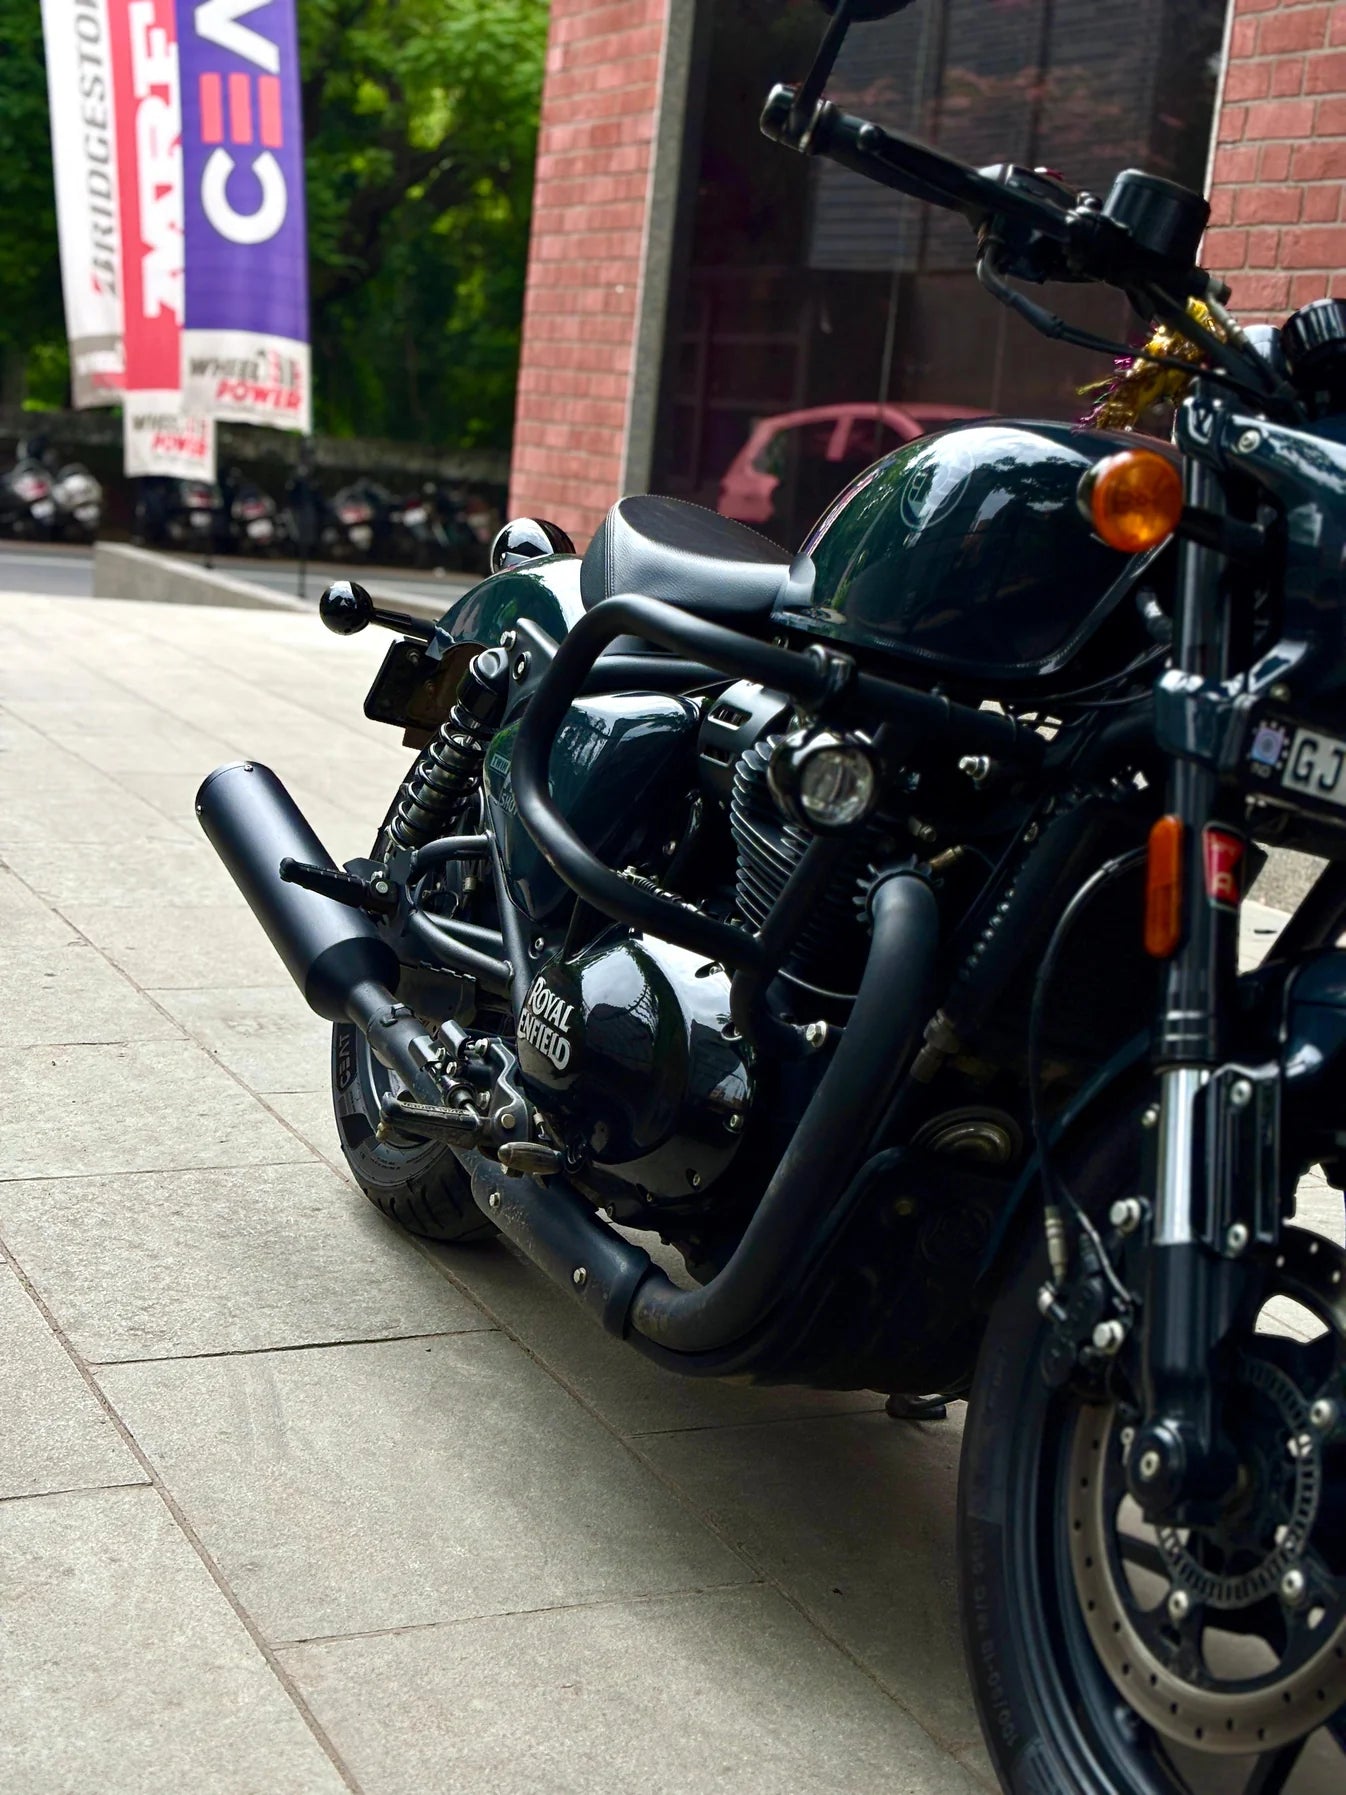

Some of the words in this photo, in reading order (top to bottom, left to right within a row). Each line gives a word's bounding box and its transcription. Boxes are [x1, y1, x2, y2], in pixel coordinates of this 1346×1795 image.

[128, 1, 184, 326] MRF
[1293, 738, 1345, 792] GJ
[528, 976, 575, 1033] ROYAL
[338, 1033, 351, 1089] CEAT
[517, 1008, 571, 1071] ENFIELD
